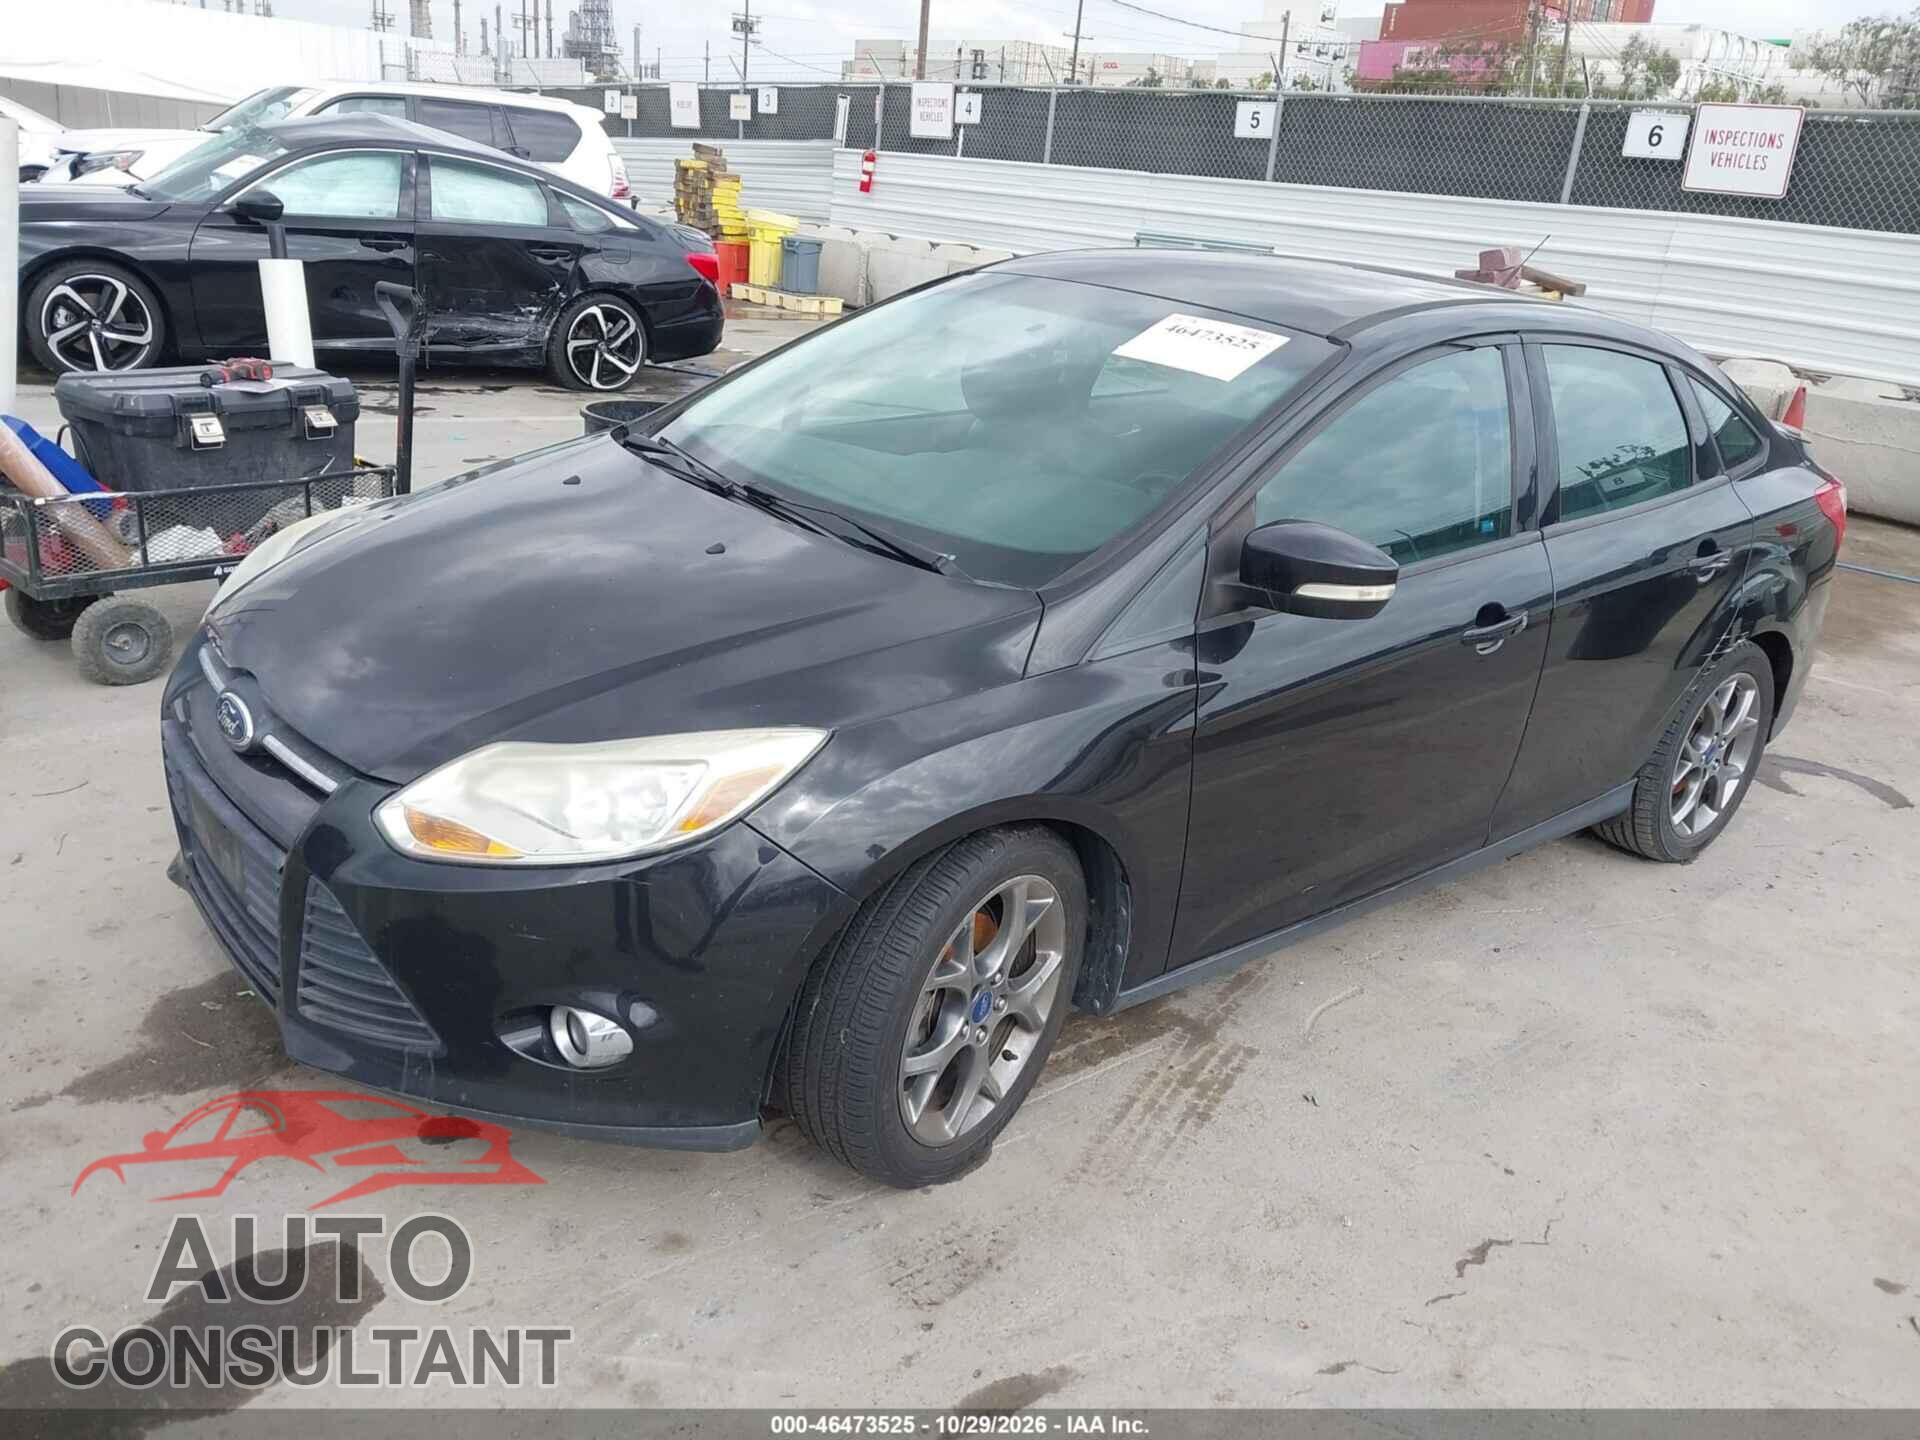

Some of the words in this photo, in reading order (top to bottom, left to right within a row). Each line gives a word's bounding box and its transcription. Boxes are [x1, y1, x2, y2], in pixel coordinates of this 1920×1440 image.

[763, 93, 771, 107] 3
[964, 101, 972, 116] 4
[1250, 111, 1260, 129] 5
[1647, 125, 1664, 147] 6
[1704, 128, 1785, 149] INSPECTIONS
[1710, 150, 1768, 171] VEHICLES
